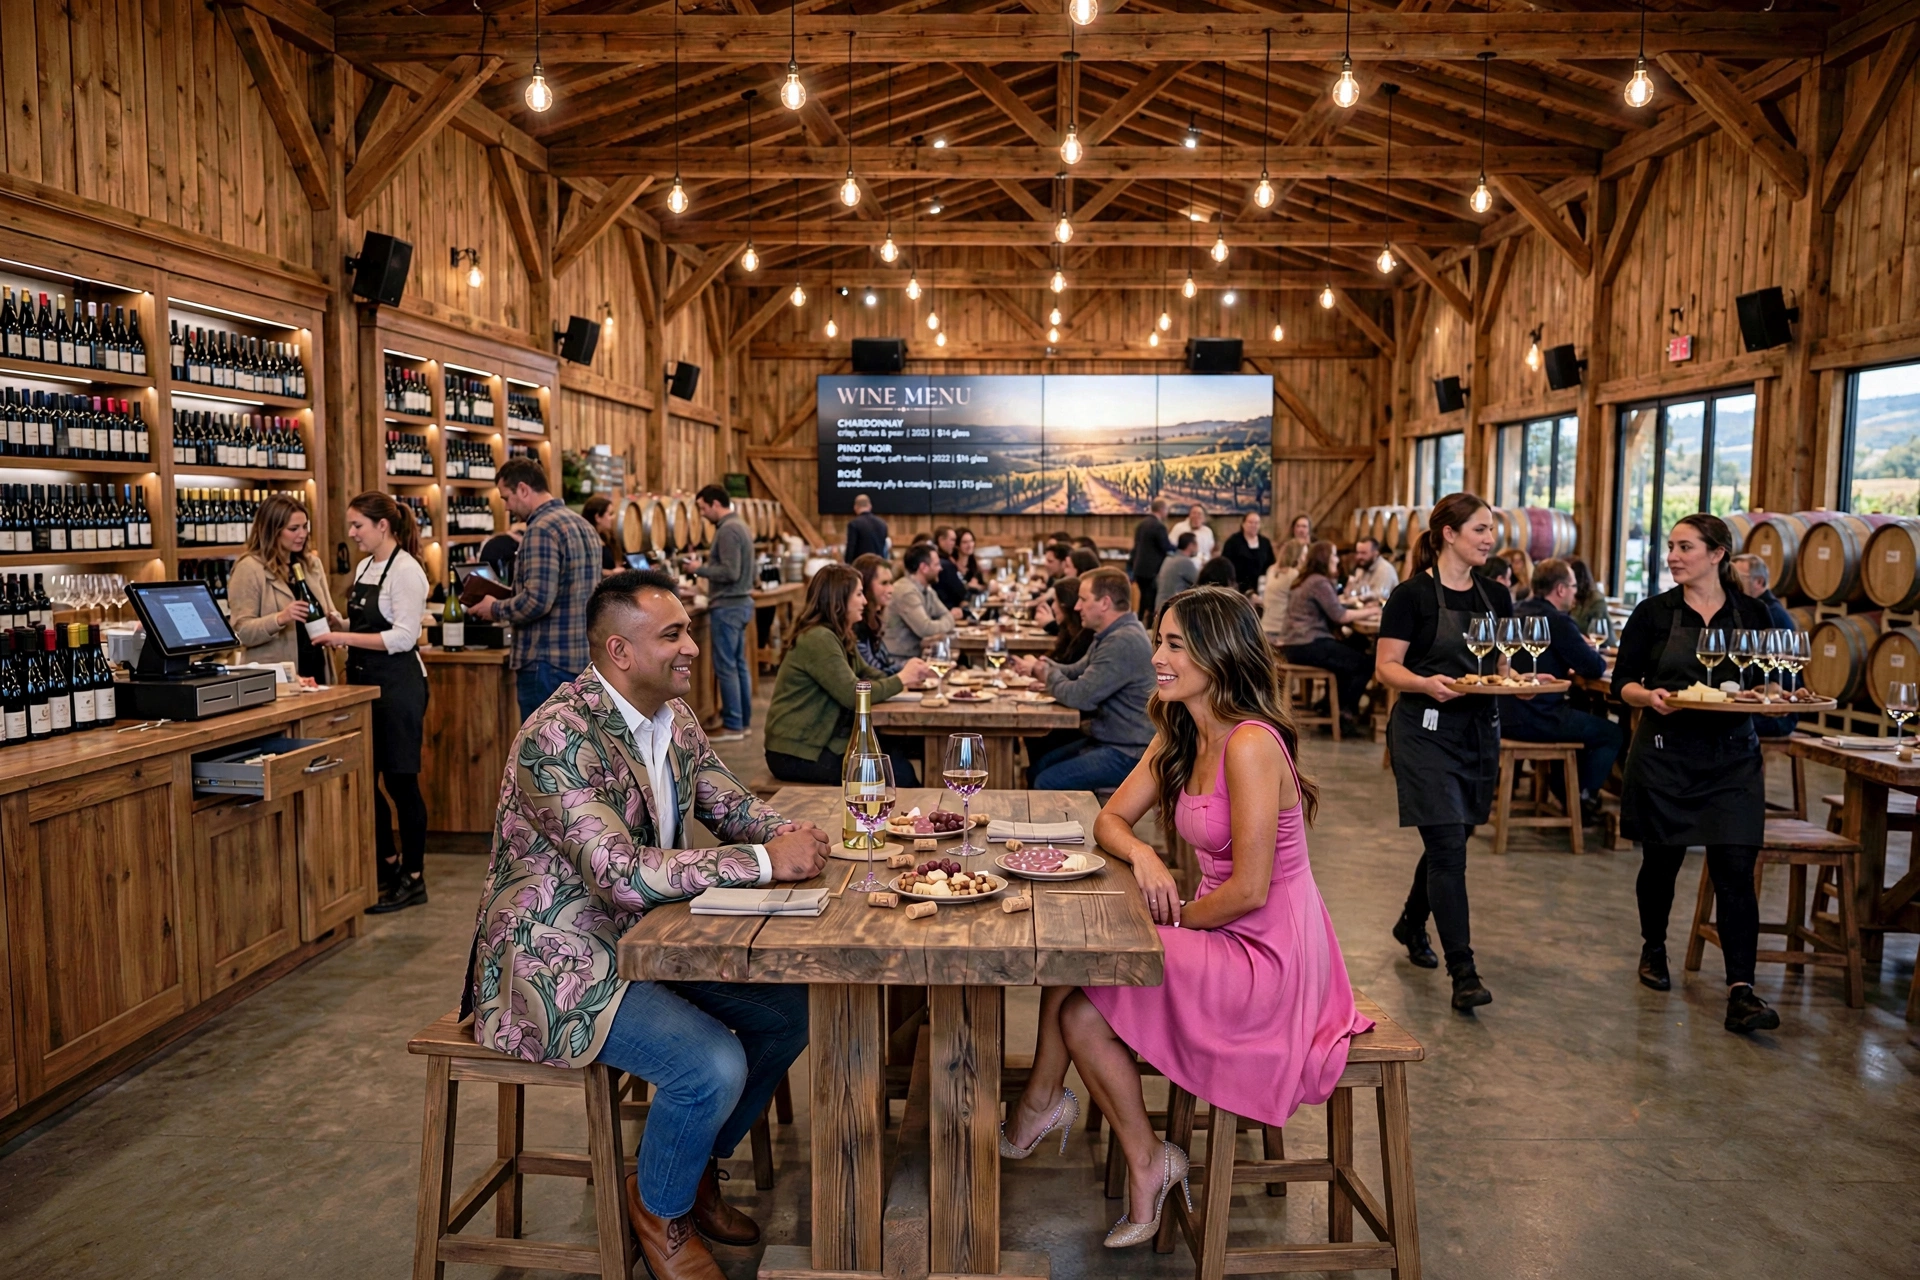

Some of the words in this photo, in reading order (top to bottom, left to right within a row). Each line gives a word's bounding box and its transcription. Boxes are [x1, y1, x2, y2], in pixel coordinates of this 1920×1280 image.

[837, 387, 896, 405] WINE
[904, 387, 971, 405] MENU
[837, 418, 904, 428] CHARDONNAY
[837, 443, 866, 453] PINOT
[868, 443, 892, 453] NOIR
[837, 467, 861, 478] ROSÉ
